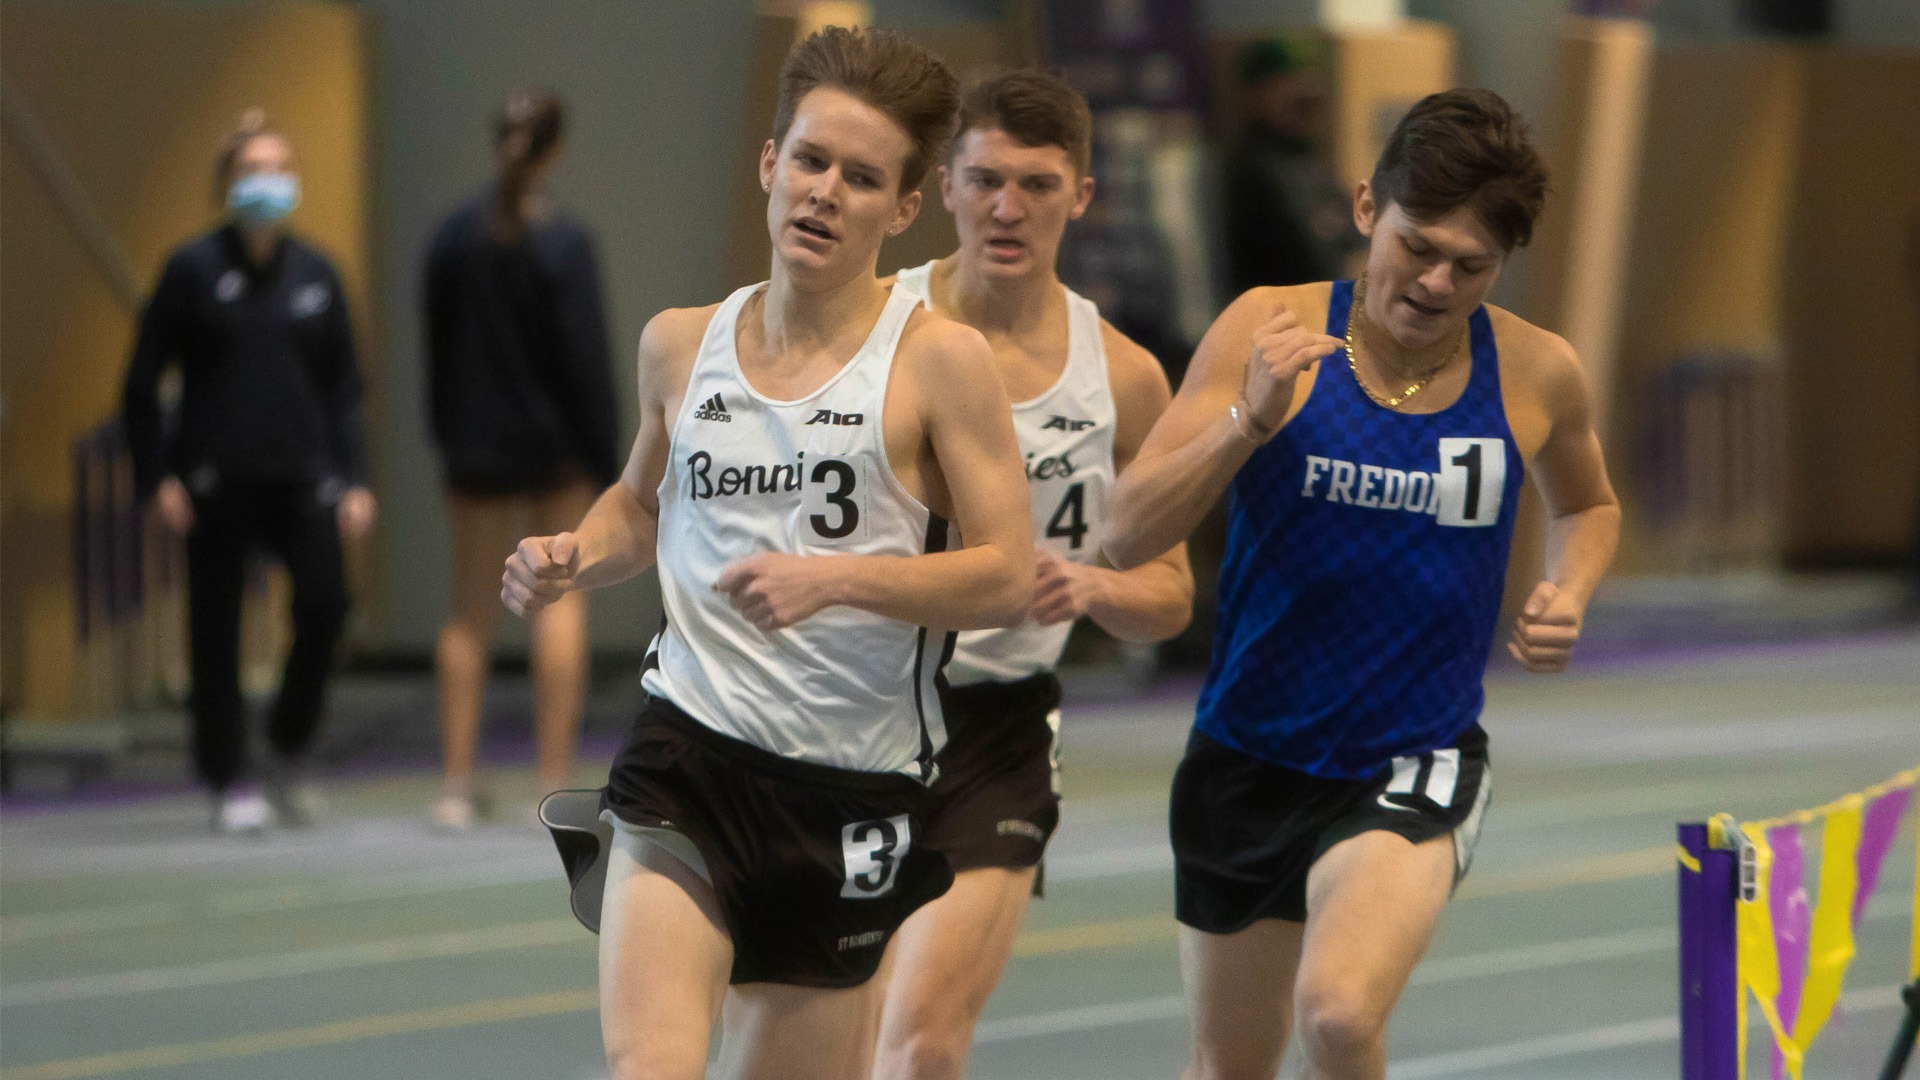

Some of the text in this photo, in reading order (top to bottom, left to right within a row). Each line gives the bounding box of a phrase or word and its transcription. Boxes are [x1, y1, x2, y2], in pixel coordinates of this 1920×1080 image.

[693, 408, 732, 423] adidas
[805, 409, 864, 426] A10
[687, 450, 804, 501] Bonni
[1025, 451, 1075, 480] ies
[1451, 443, 1483, 521] 1
[809, 459, 859, 539] 3
[1046, 481, 1088, 549] 4
[852, 819, 898, 892] 3
